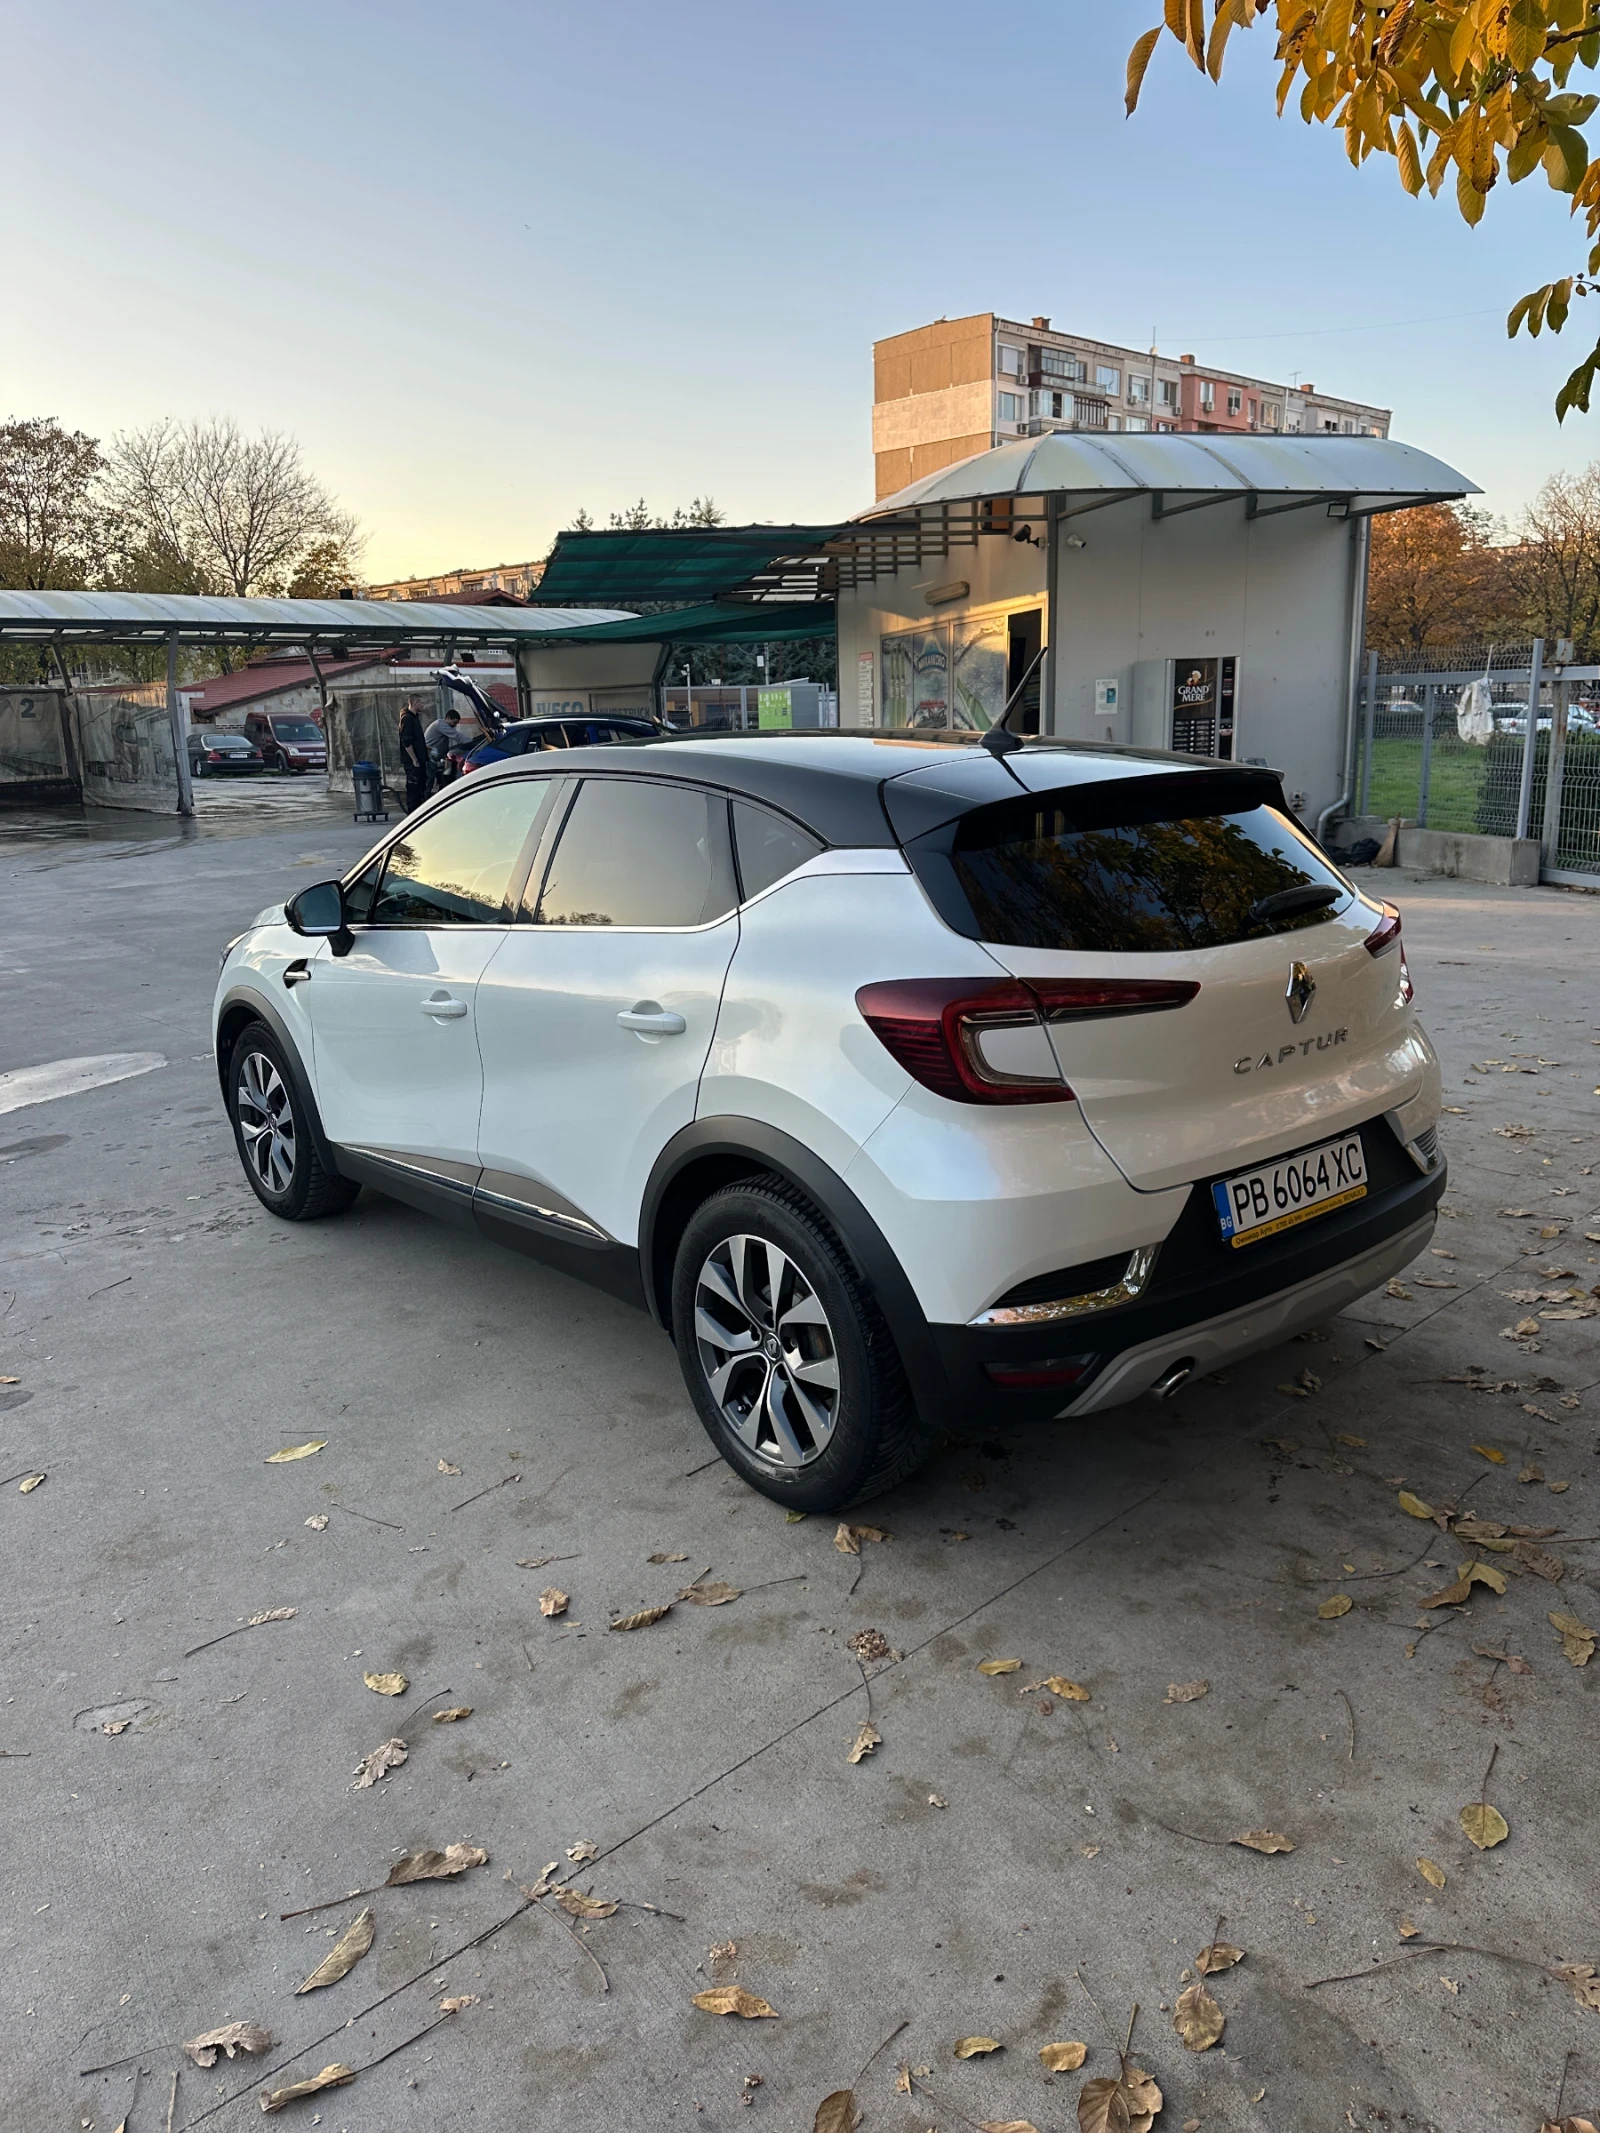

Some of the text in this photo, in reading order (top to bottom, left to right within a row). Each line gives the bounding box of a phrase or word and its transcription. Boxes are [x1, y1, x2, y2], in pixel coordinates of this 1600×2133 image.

[20, 697, 37, 718] 2
[1233, 1026, 1348, 1074] CAPTUR
[1232, 1143, 1362, 1225] PB 6064 XC
[1220, 1215, 1233, 1231] BG
